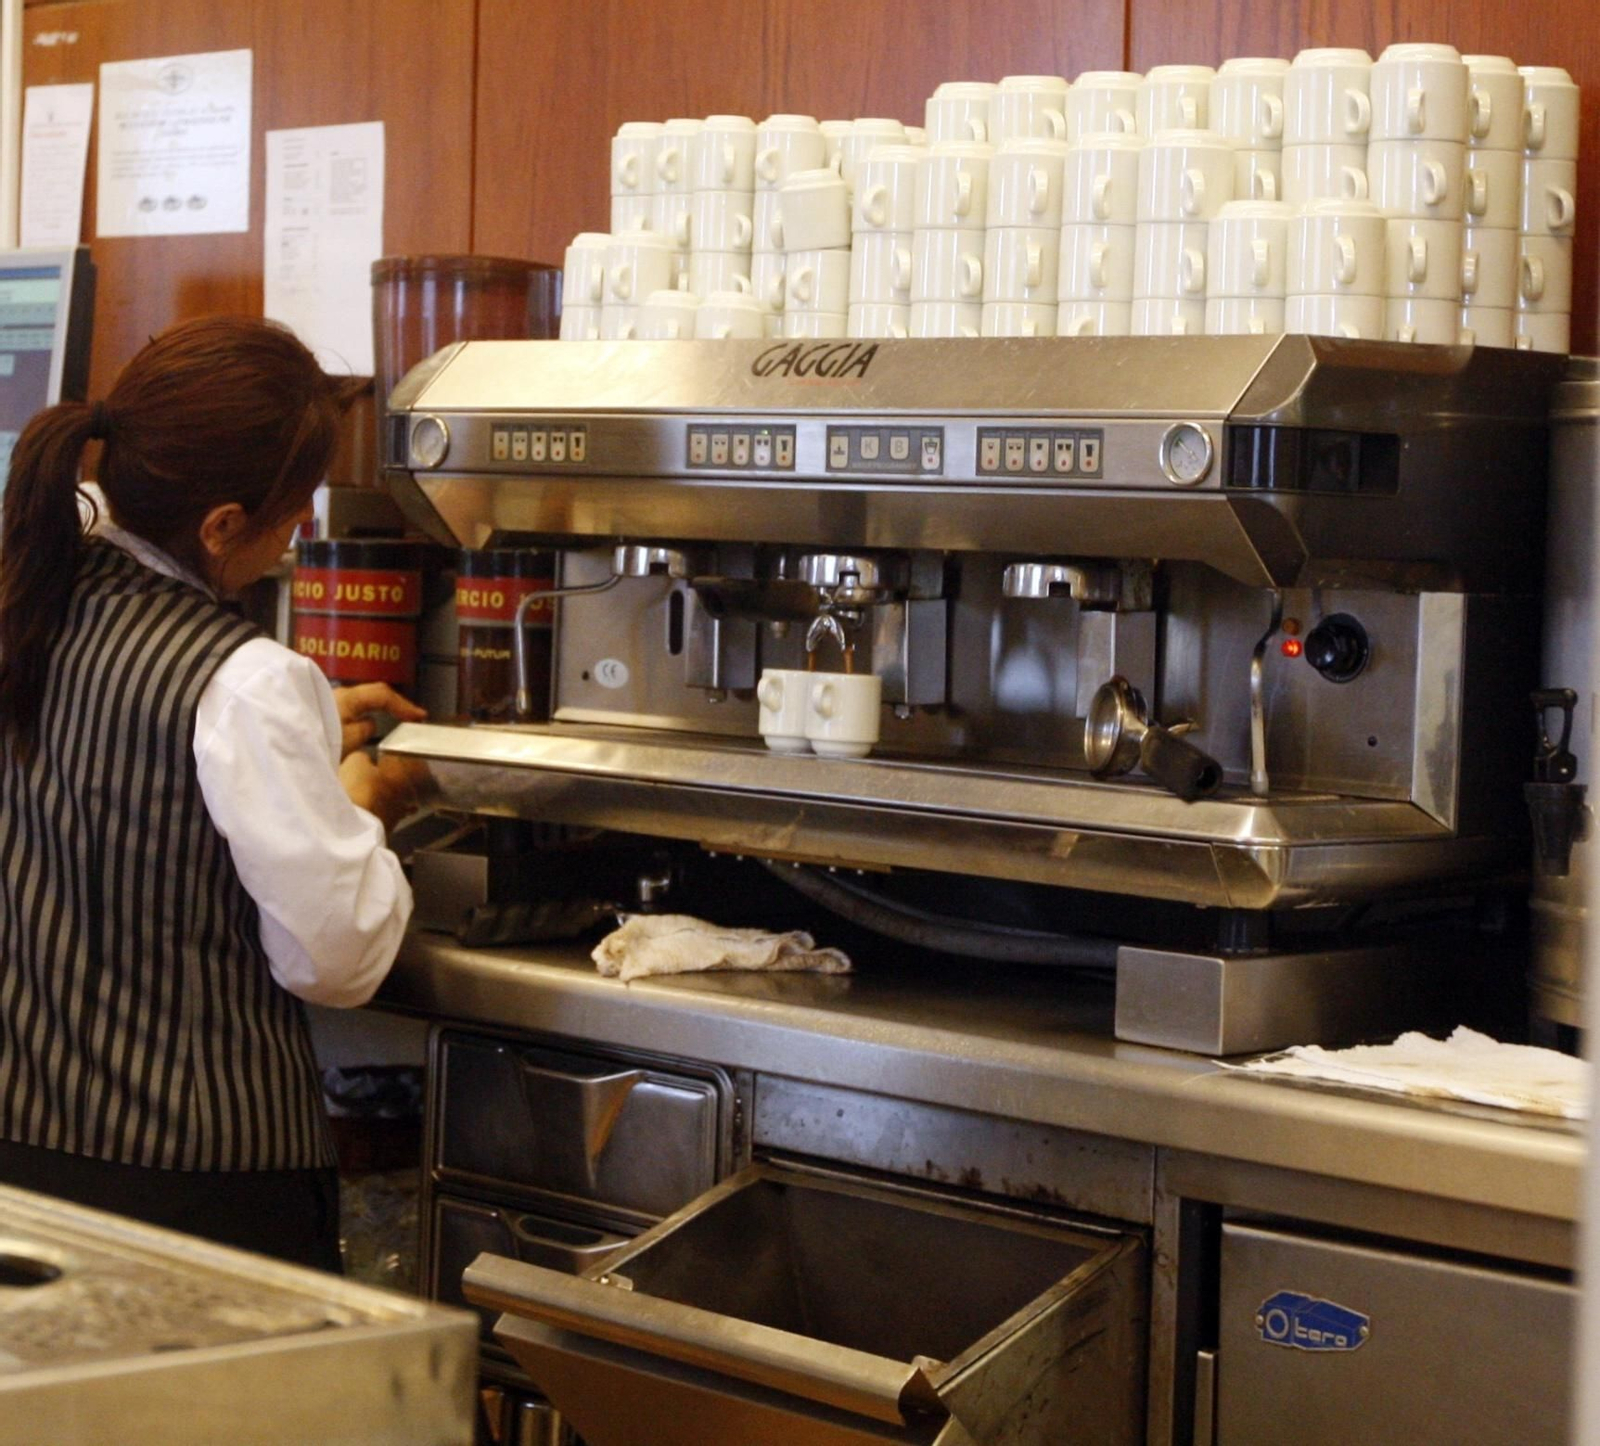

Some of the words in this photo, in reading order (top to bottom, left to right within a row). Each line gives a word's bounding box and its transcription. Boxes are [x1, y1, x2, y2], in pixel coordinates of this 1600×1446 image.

[752, 343, 880, 378] GAGGIA
[334, 583, 403, 603] JUSTO
[457, 588, 504, 609] RCIO
[300, 637, 401, 661] SOLIDARIO
